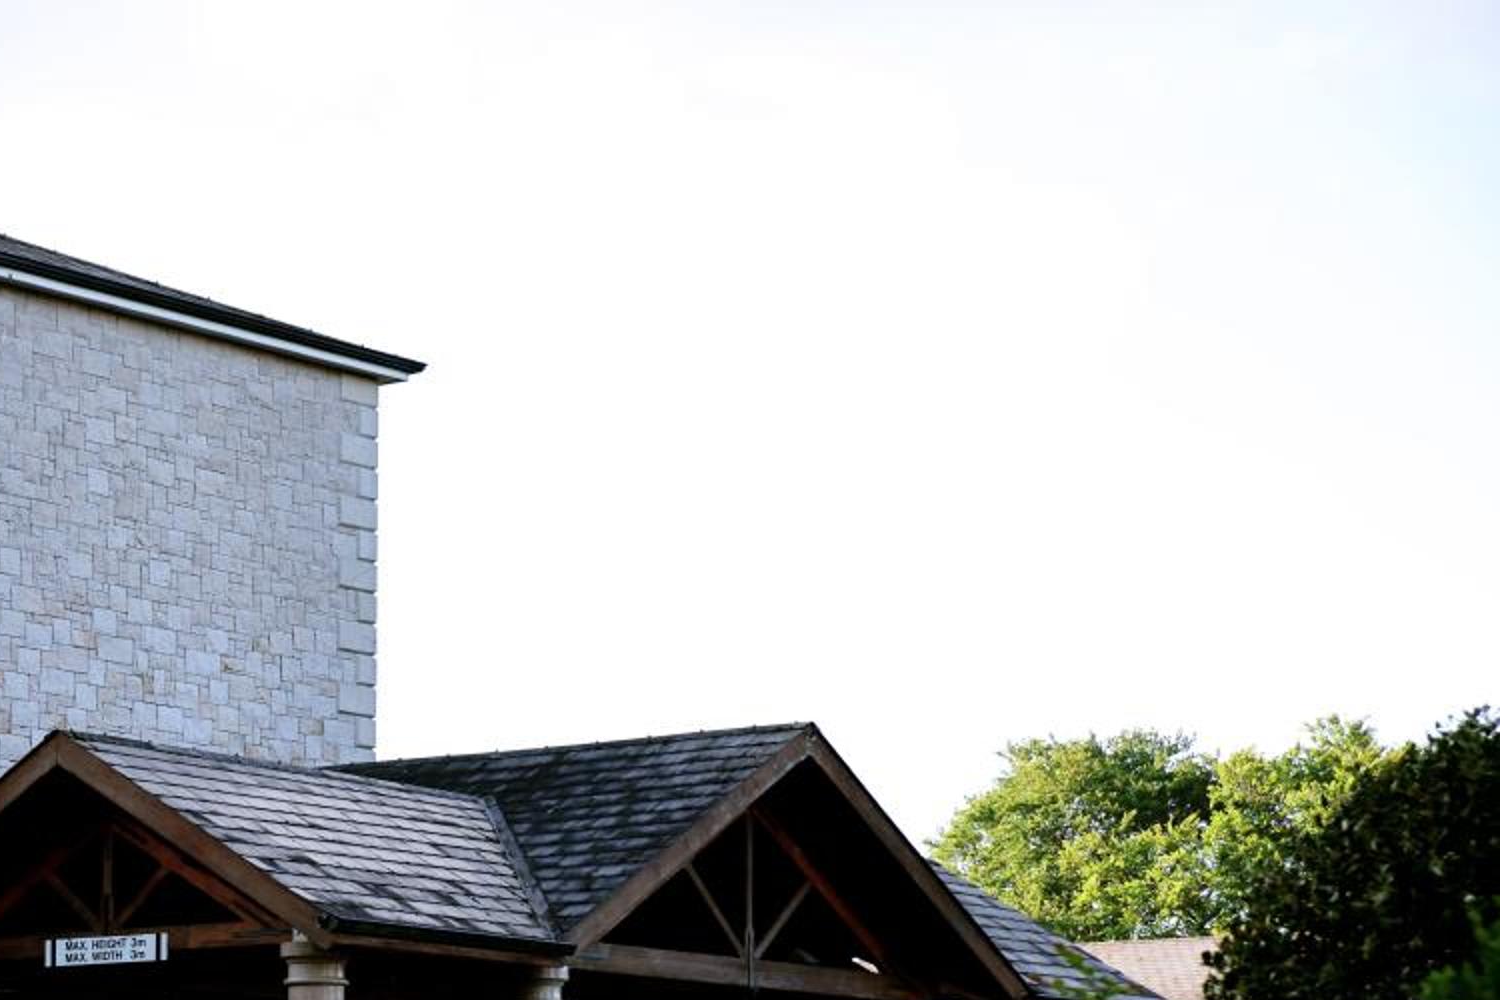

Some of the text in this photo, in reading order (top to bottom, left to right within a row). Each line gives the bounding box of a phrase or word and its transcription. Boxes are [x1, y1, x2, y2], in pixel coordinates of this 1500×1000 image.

[91, 937, 127, 949] HEIGHT
[131, 937, 147, 947] 3m
[91, 950, 123, 961] WIDTH
